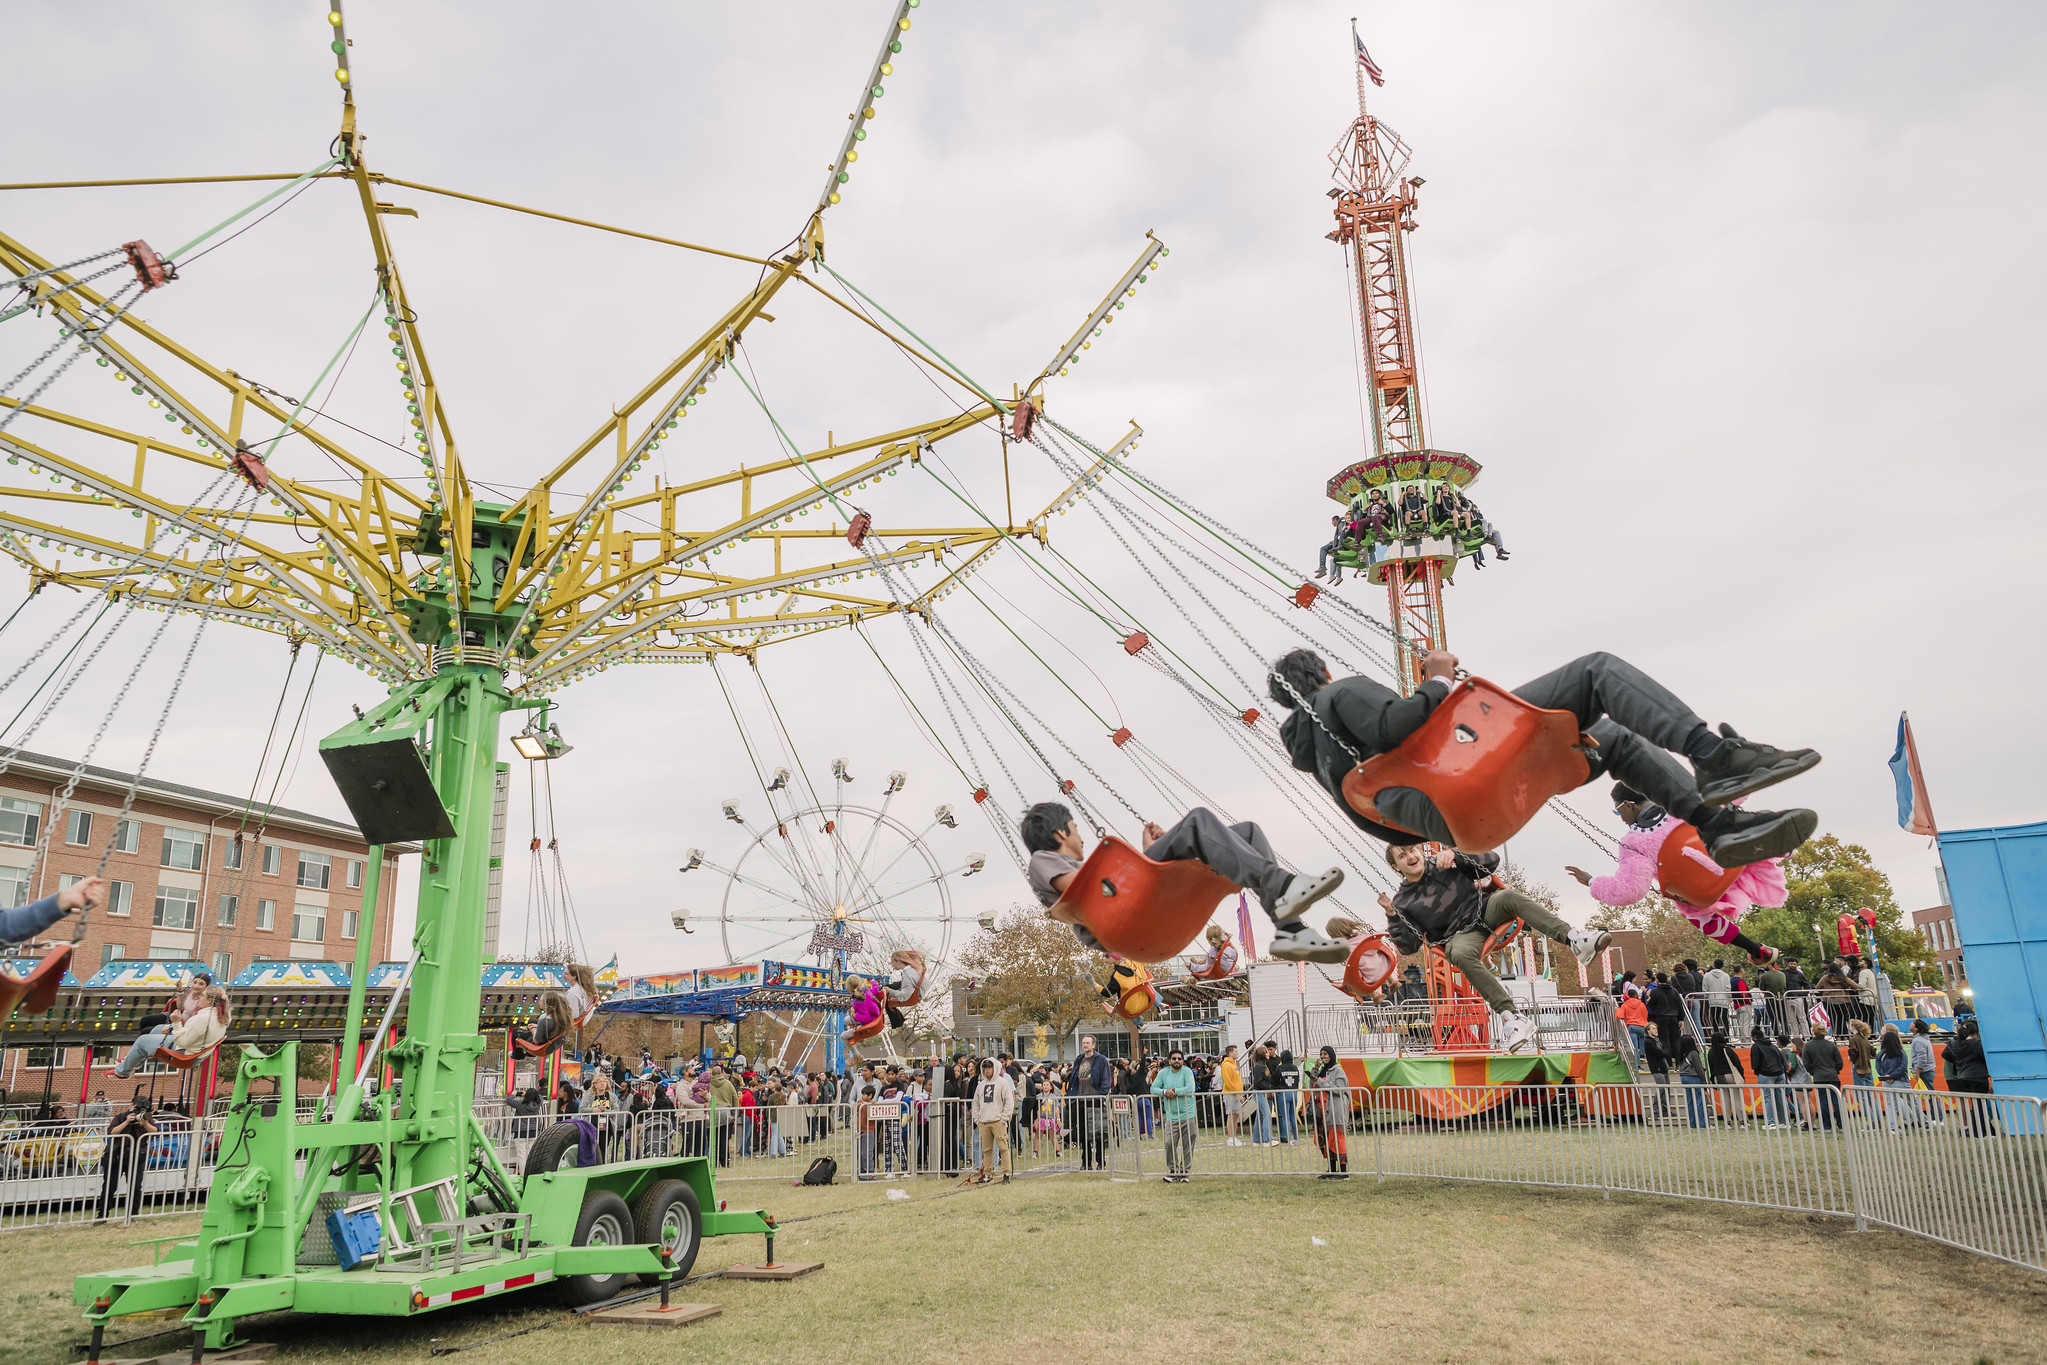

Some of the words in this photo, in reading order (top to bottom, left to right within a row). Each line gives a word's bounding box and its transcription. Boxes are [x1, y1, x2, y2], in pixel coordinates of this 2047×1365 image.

[1390, 454, 1425, 466] SUPER
[1396, 460, 1421, 471] SHOT
[1428, 454, 1459, 466] SUPER
[1356, 460, 1389, 475] SUPER
[1364, 466, 1385, 479] SHOT
[1115, 1100, 1126, 1109] EXIT
[872, 1106, 897, 1116] ENTRANCE
